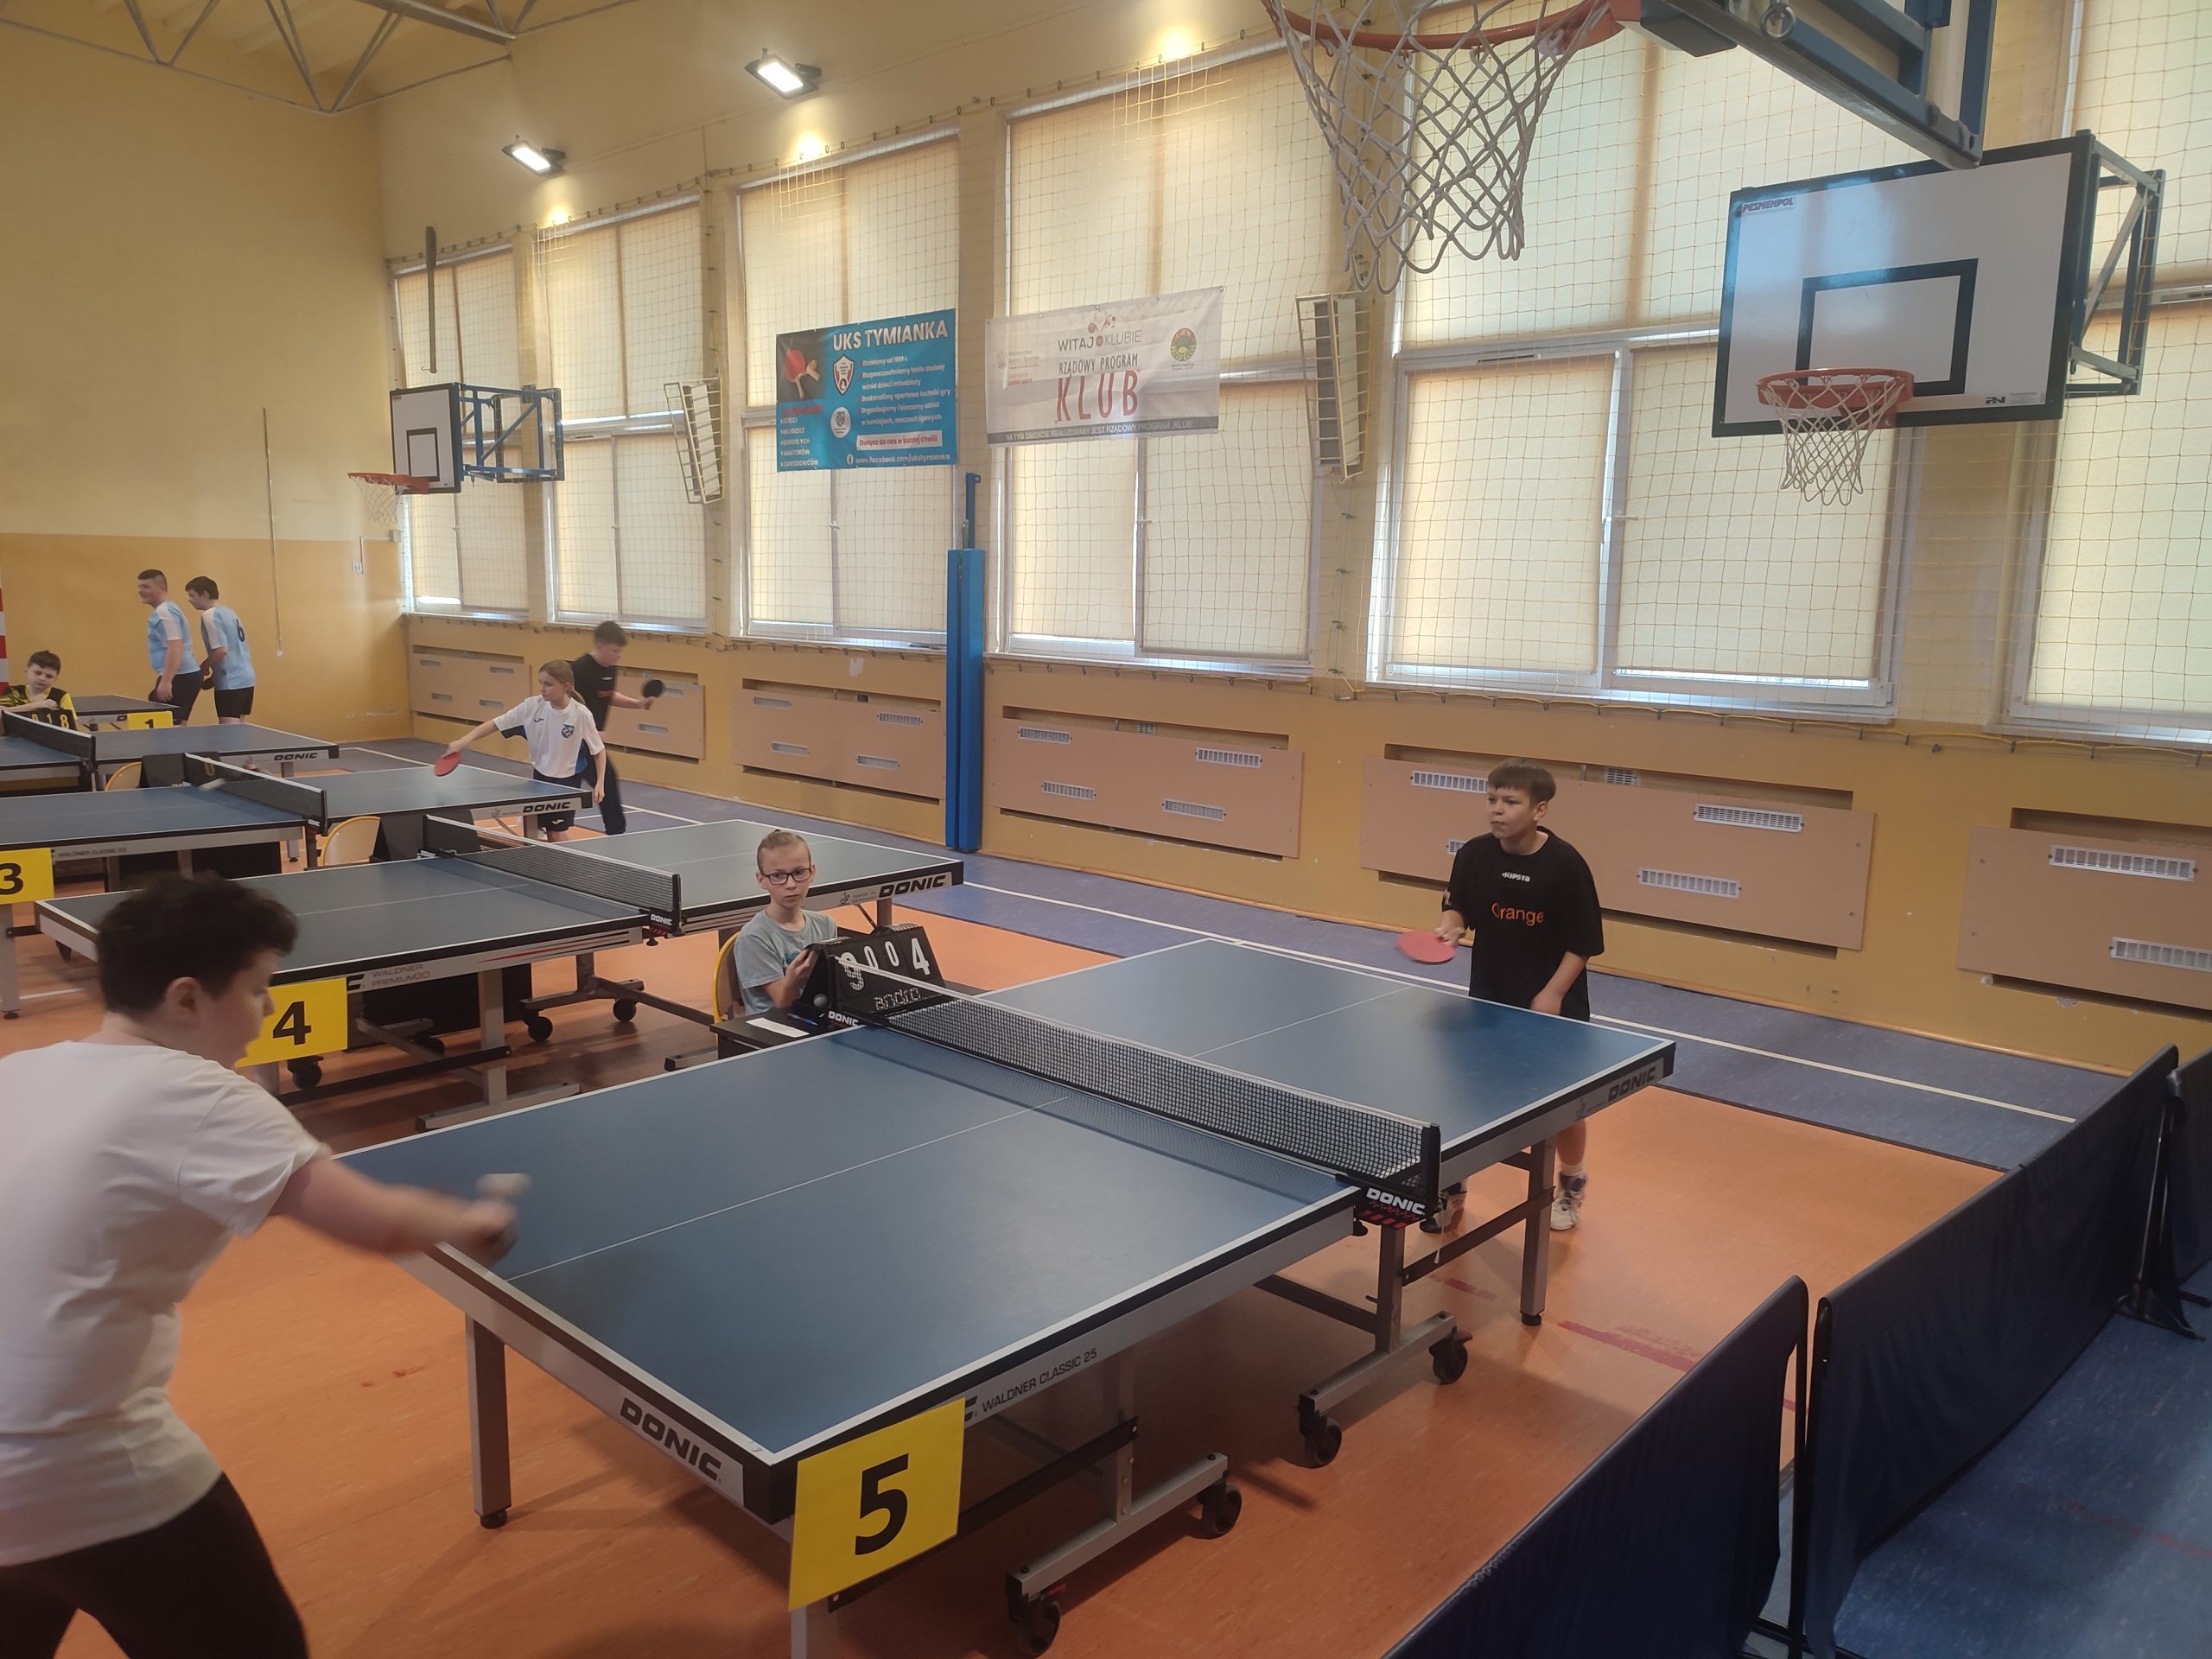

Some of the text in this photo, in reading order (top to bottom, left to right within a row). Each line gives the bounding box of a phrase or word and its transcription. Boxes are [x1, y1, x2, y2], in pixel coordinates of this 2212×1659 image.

[832, 320, 949, 351] UKS TYMIANKA
[1058, 336, 1094, 352] WITAJ
[1104, 330, 1141, 346] KLUBIE
[1058, 358, 1096, 375] RZĄDOWY
[1100, 353, 1139, 372] PROGRAM
[1106, 423, 1137, 434] RZĄDOWY
[1138, 421, 1171, 431] PROGRAM
[859, 438, 879, 447] Dołącz
[59, 714, 70, 729] 8
[273, 752, 319, 761] DONIC
[522, 801, 571, 814] DONIC
[0, 862, 24, 895] 3
[878, 874, 946, 899] DONIC
[650, 913, 673, 926] DONIC
[1491, 902, 1545, 927] Orange
[372, 963, 423, 977] WALDNER
[841, 951, 865, 992] 9
[885, 940, 899, 967] 0
[911, 938, 931, 976] 4
[272, 1001, 312, 1046] 4
[828, 1010, 859, 1027] DONIC
[1607, 1065, 1657, 1103] DONIC
[1365, 1187, 1427, 1217] DONIC
[982, 1376, 1038, 1414] WALDNER
[1039, 1356, 1082, 1385] CLASSIC
[1084, 1347, 1097, 1363] 25
[620, 1396, 722, 1482] DONIC
[855, 1452, 910, 1556] 5
